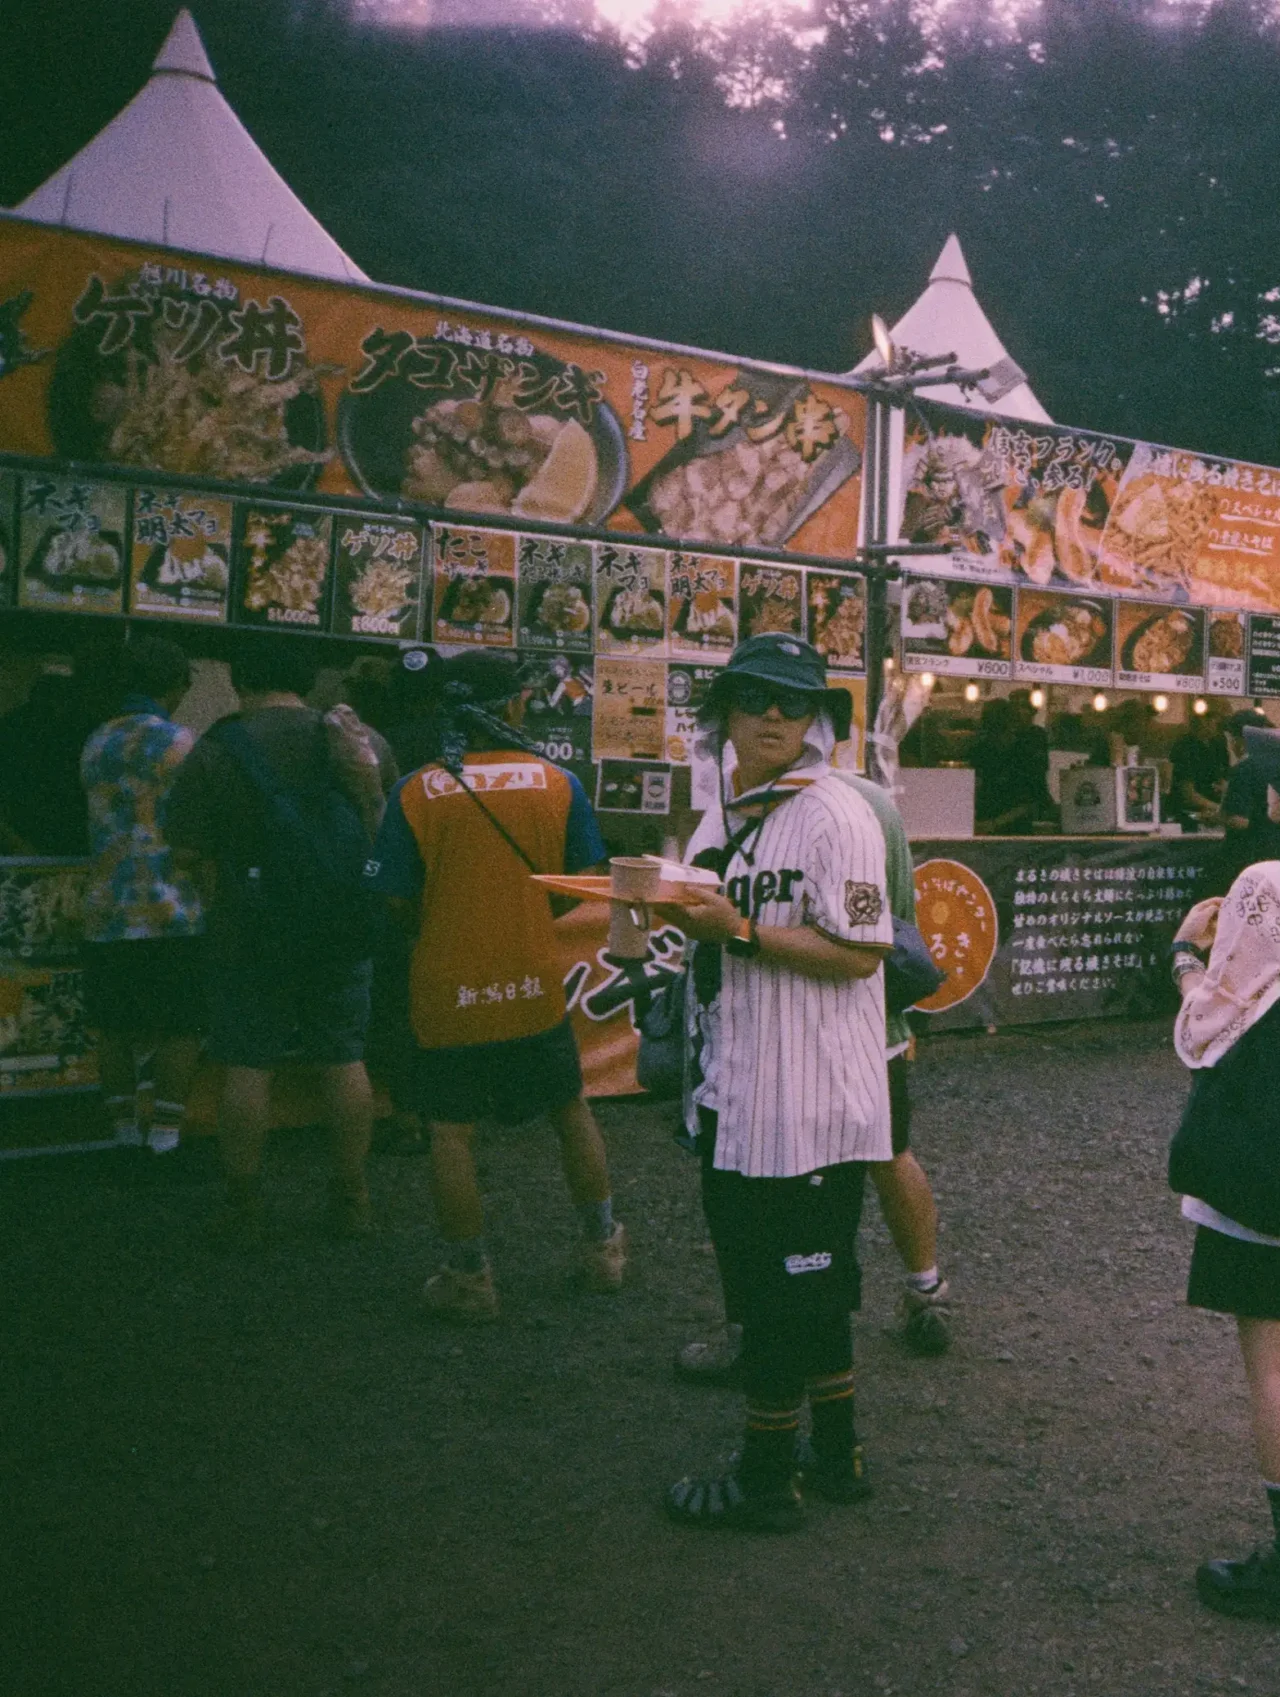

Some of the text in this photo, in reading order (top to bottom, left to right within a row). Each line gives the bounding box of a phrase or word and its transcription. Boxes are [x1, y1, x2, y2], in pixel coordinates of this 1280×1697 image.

[434, 321, 535, 357] 北海道名物
[349, 327, 607, 424] タコザンギ
[650, 367, 838, 462] 牛タン串
[519, 539, 565, 564] ネギ
[597, 548, 644, 576] ネギ
